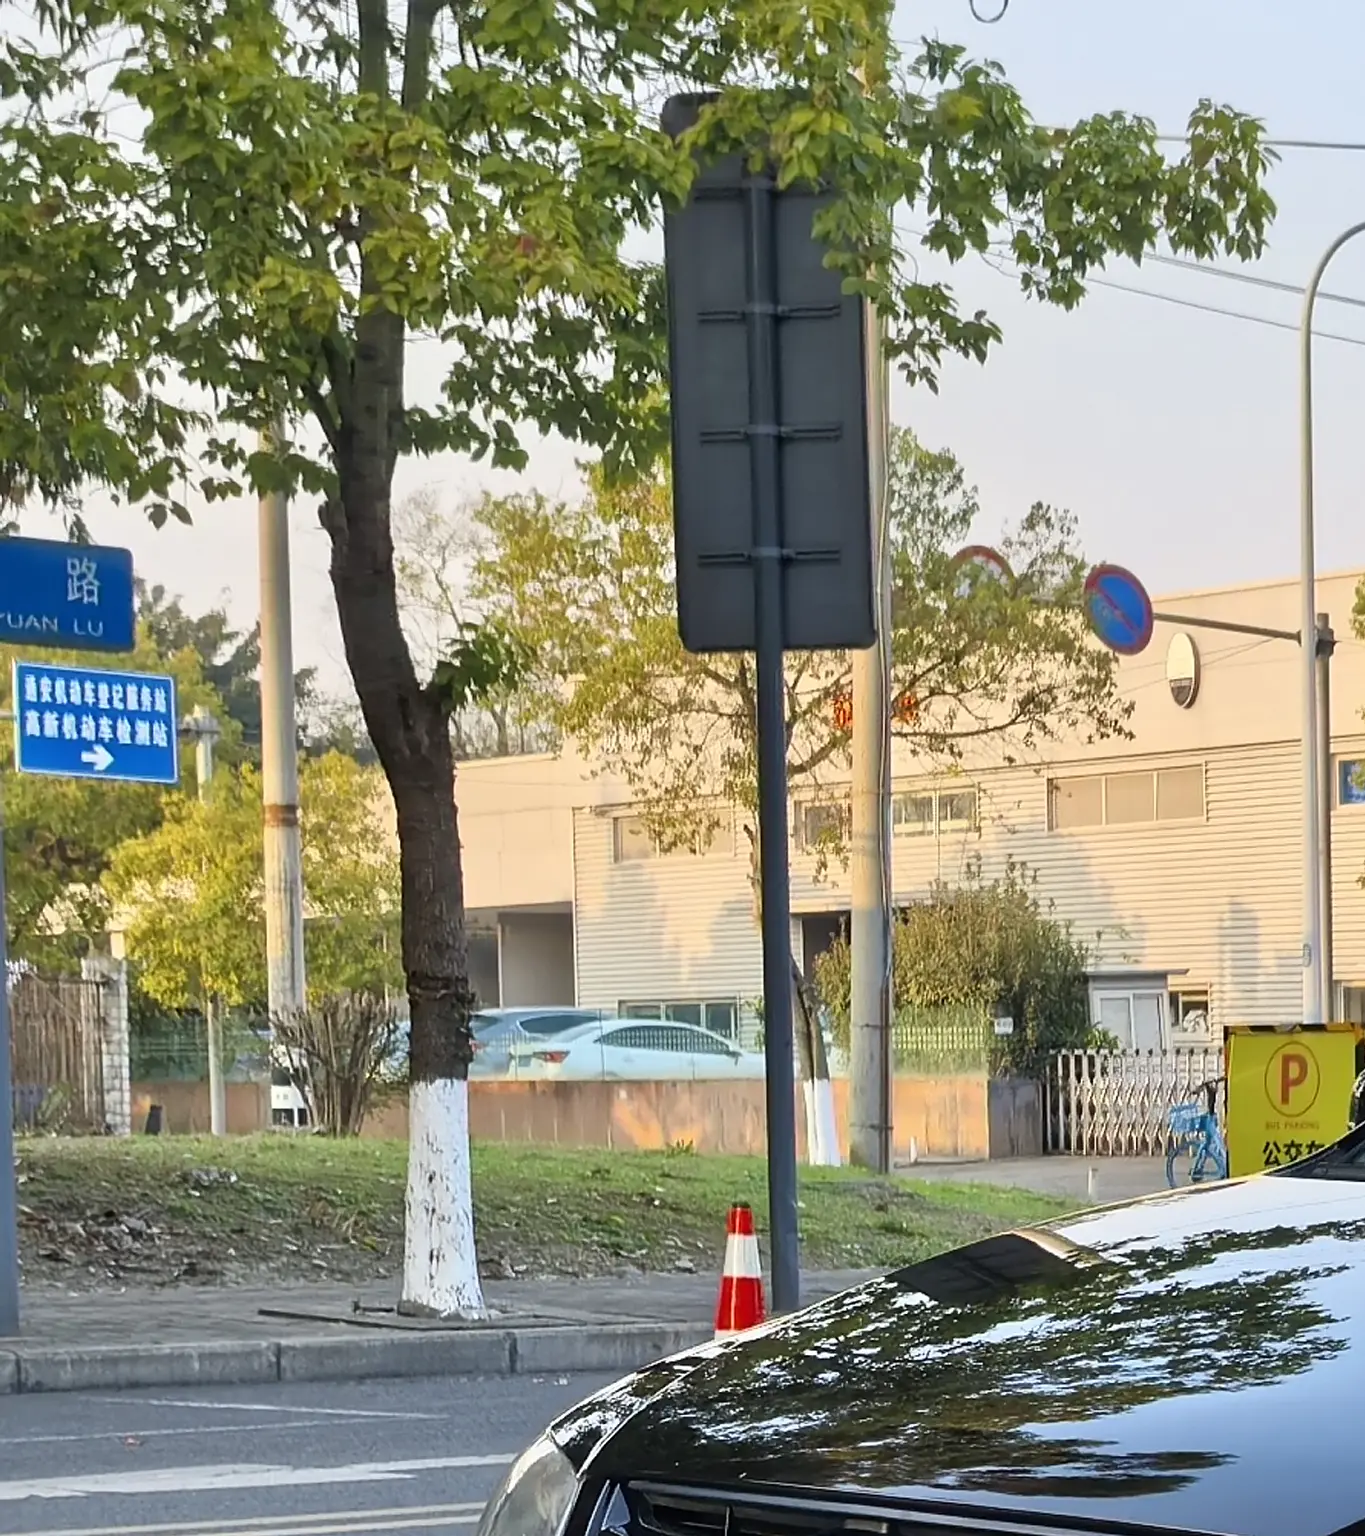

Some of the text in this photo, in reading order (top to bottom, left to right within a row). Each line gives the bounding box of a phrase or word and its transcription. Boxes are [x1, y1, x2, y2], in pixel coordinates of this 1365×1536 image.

[67, 556, 100, 606] 路
[73, 617, 104, 637] LU
[1281, 1053, 1309, 1106] P
